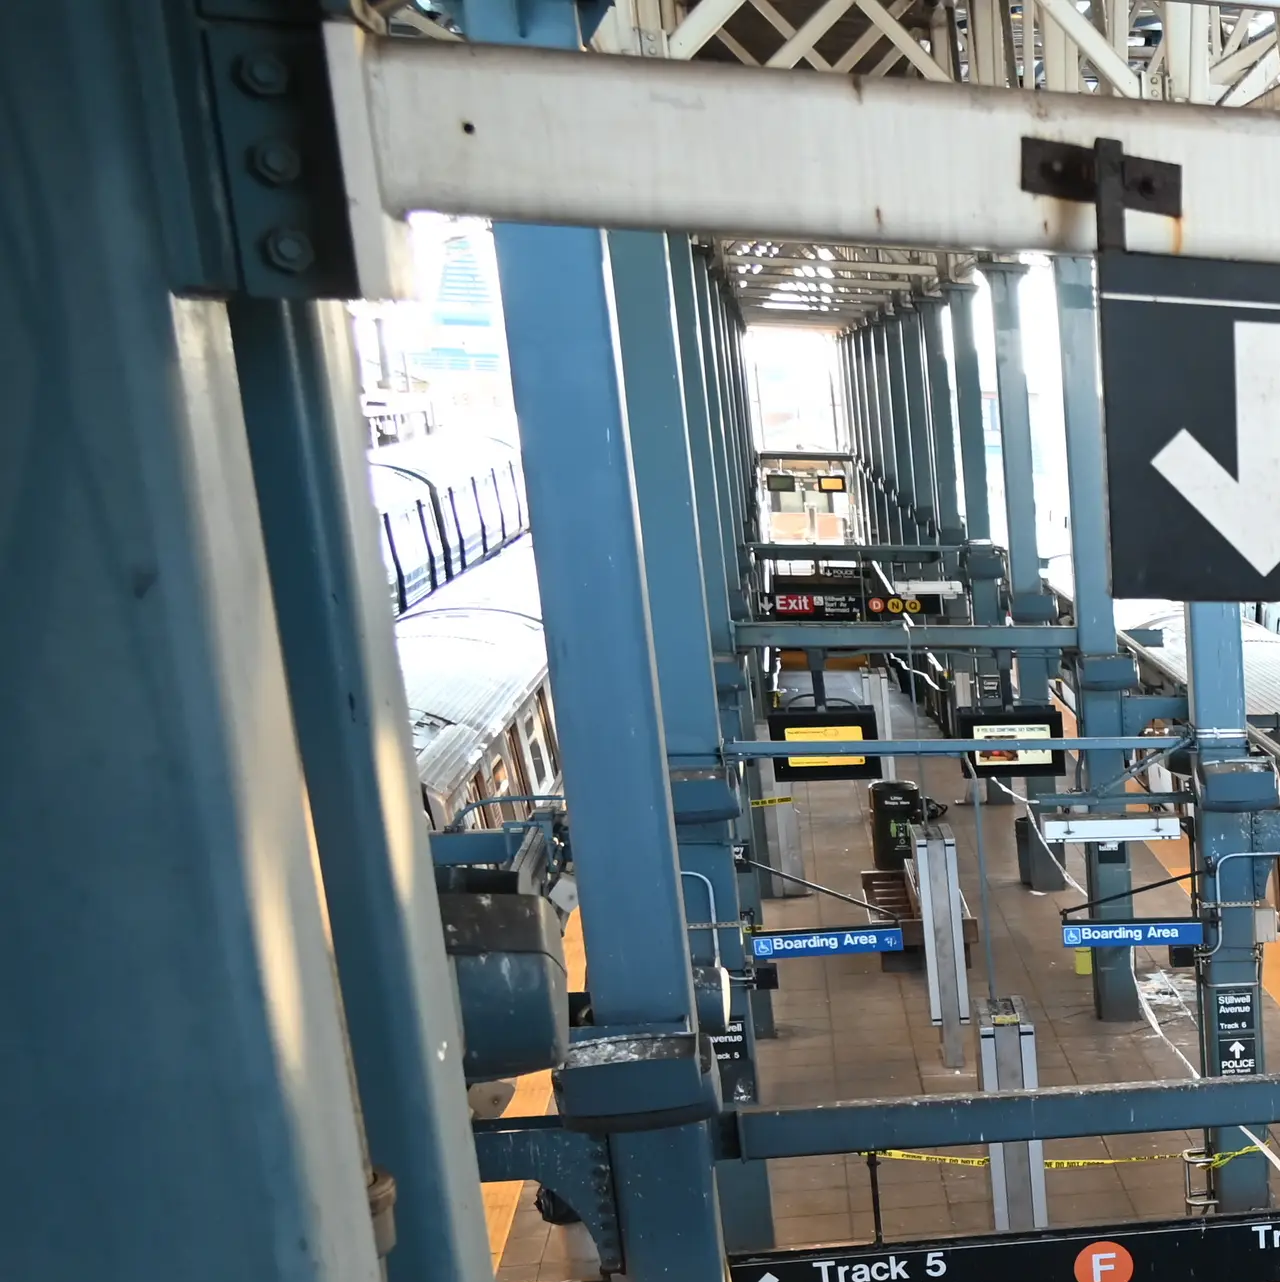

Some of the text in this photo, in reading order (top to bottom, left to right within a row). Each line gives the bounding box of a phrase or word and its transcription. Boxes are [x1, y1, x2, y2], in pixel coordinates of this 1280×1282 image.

[775, 595, 810, 610] Exit
[1081, 926, 1179, 940] Boarding Area
[773, 933, 877, 950] Boarding Area
[1218, 995, 1251, 1004] Stillwell
[1219, 1006, 1250, 1014] Avenue
[1220, 1022, 1239, 1030] Track
[1221, 1059, 1255, 1069] POLICE
[925, 1251, 947, 1277] 5
[1091, 1252, 1116, 1282] F
